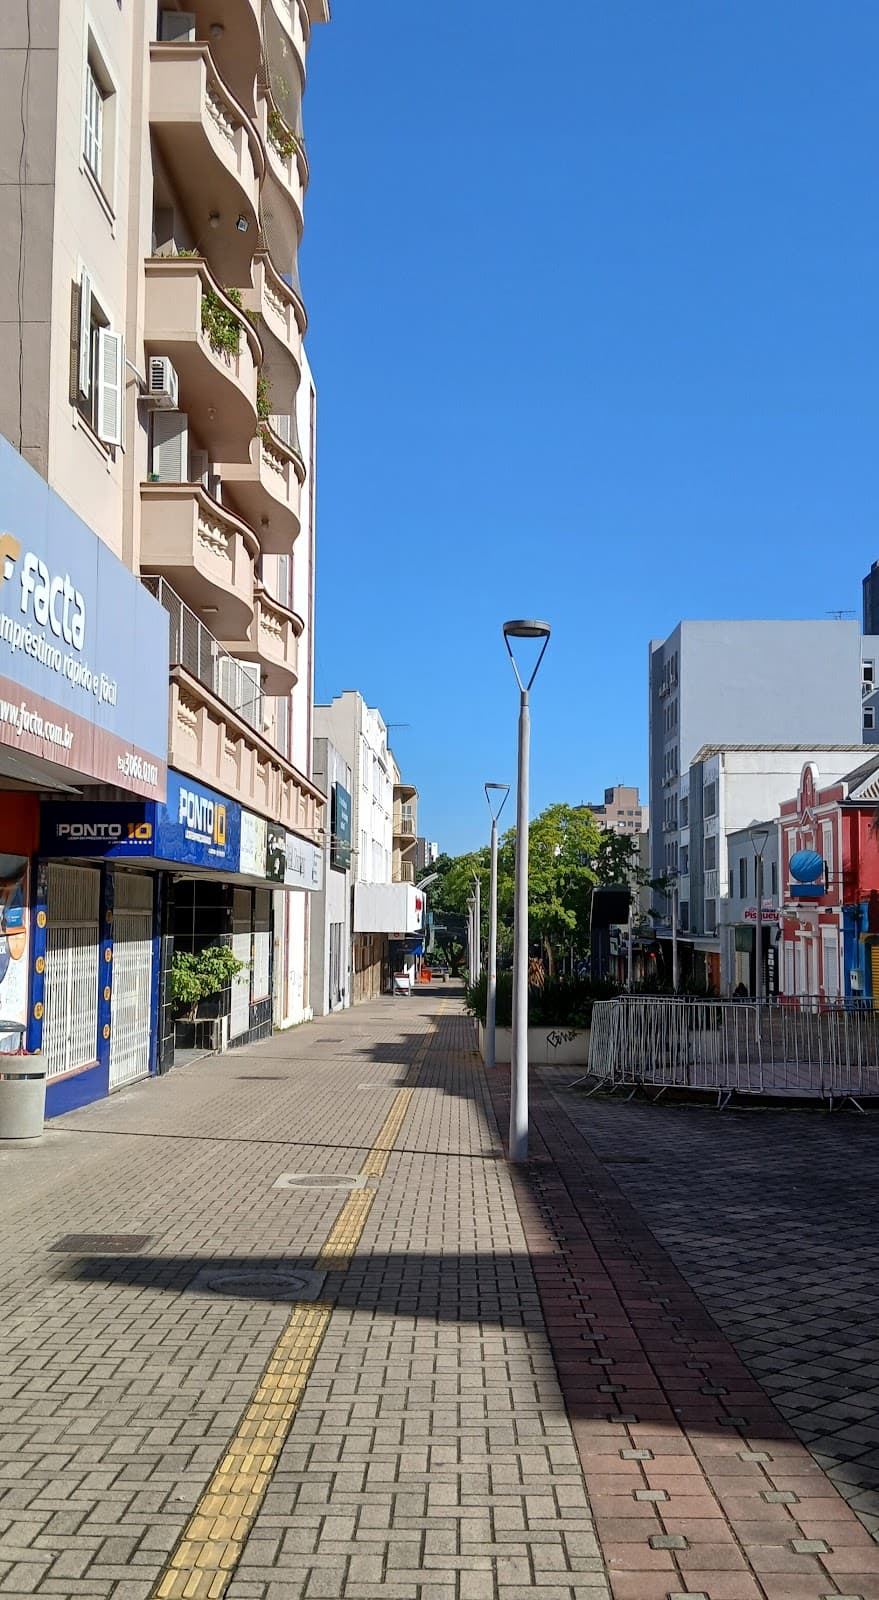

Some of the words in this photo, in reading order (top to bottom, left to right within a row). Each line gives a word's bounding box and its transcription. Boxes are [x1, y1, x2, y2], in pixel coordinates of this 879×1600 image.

[20, 551, 86, 651] facta
[0, 612, 62, 673] mpréstimo
[62, 652, 93, 691] rápido
[92, 674, 99, 696] e
[98, 672, 118, 706] fácil
[58, 823, 122, 836] PONTO
[127, 822, 153, 839] 10
[179, 787, 214, 834] PONTO
[213, 802, 226, 846] 10
[744, 911, 779, 921] Pisuey
